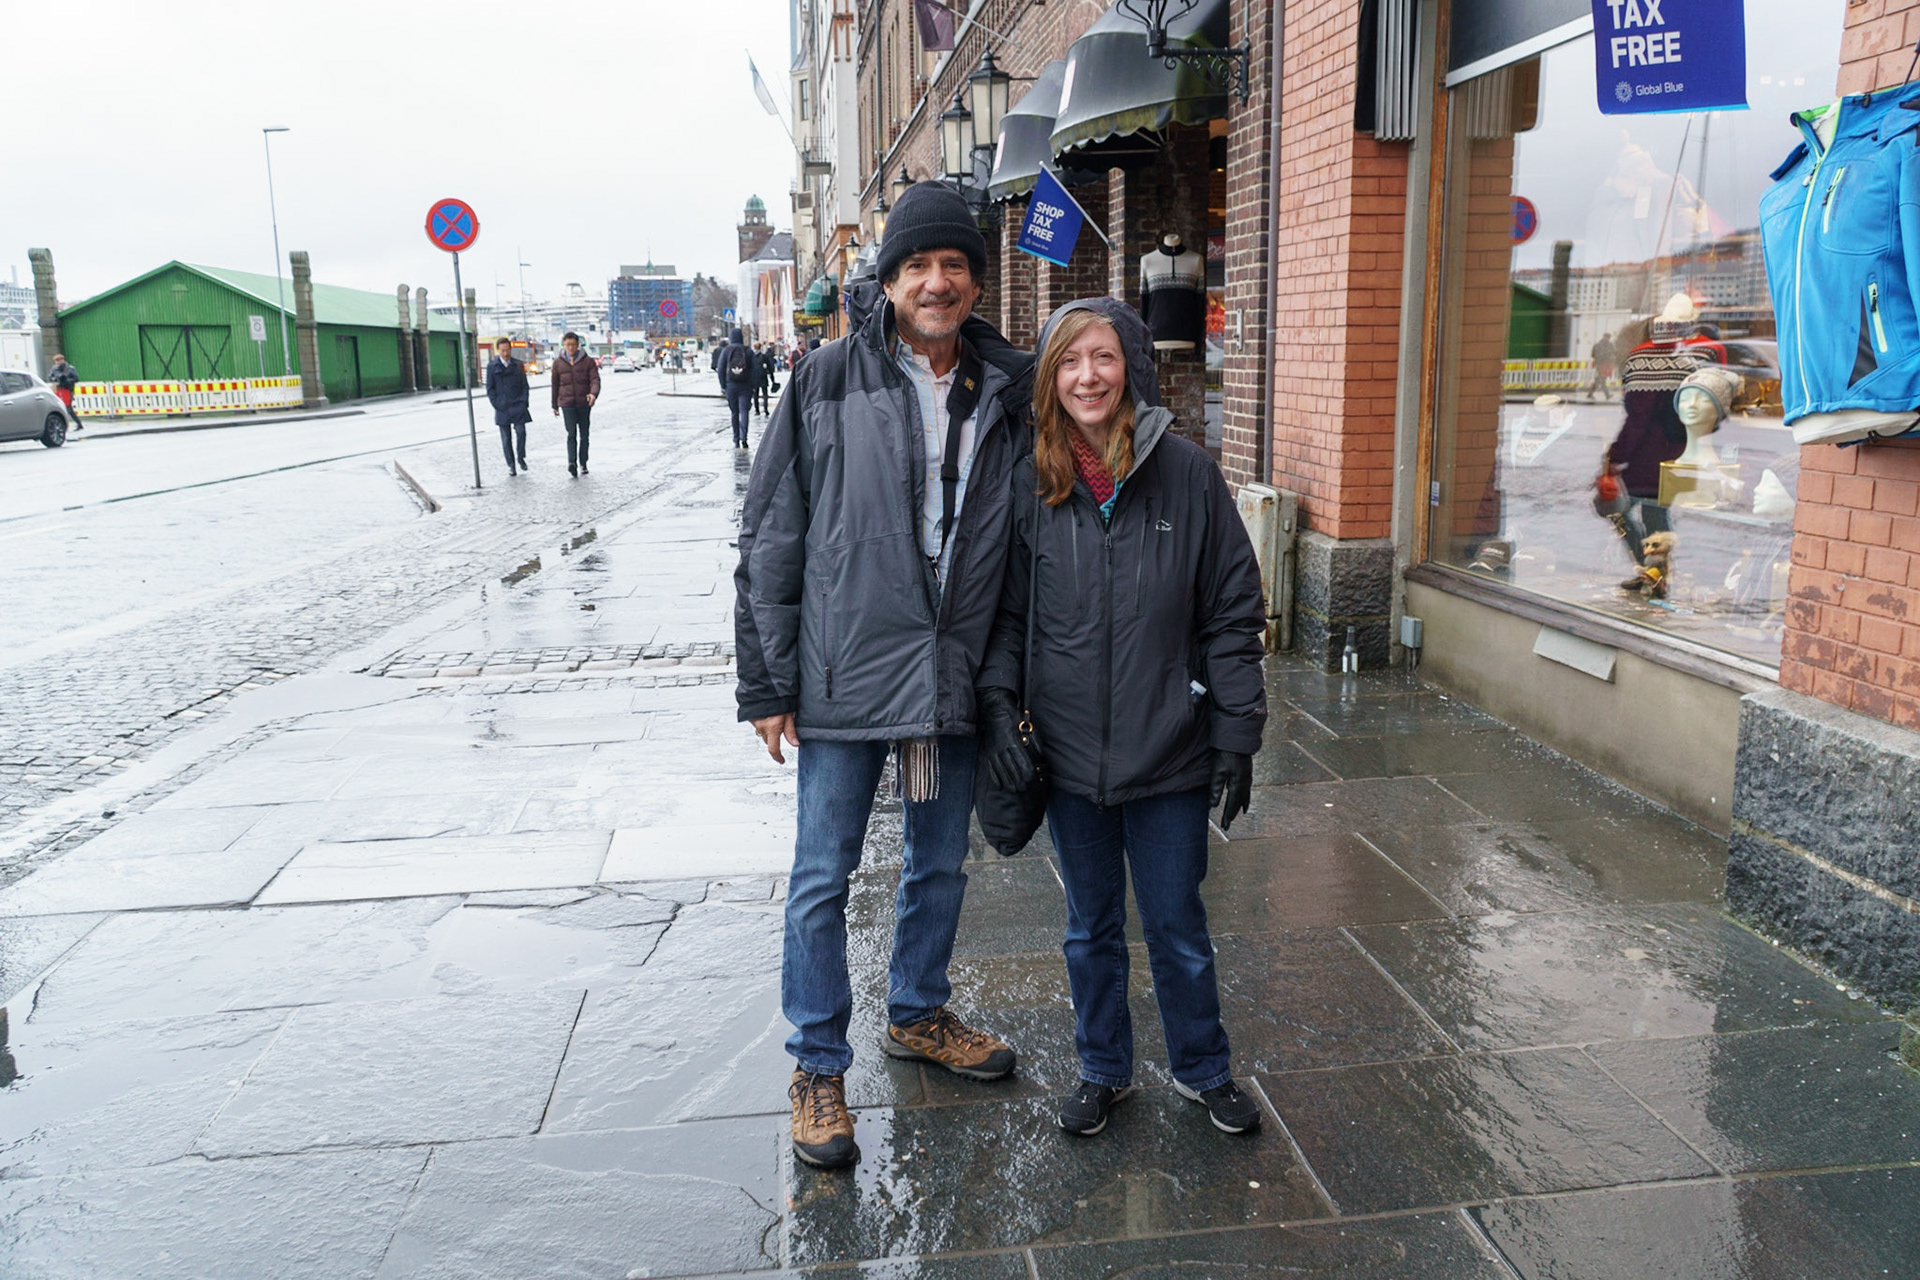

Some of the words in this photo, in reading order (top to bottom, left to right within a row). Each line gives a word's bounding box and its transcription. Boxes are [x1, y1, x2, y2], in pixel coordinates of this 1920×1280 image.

[1607, 0, 1665, 29] TAX
[1611, 31, 1681, 68] FREE
[1635, 83, 1662, 96] Global
[1664, 82, 1684, 93] Blue
[1035, 201, 1065, 220] SHOP
[1032, 212, 1053, 229] TAX
[1027, 224, 1054, 242] FREE
